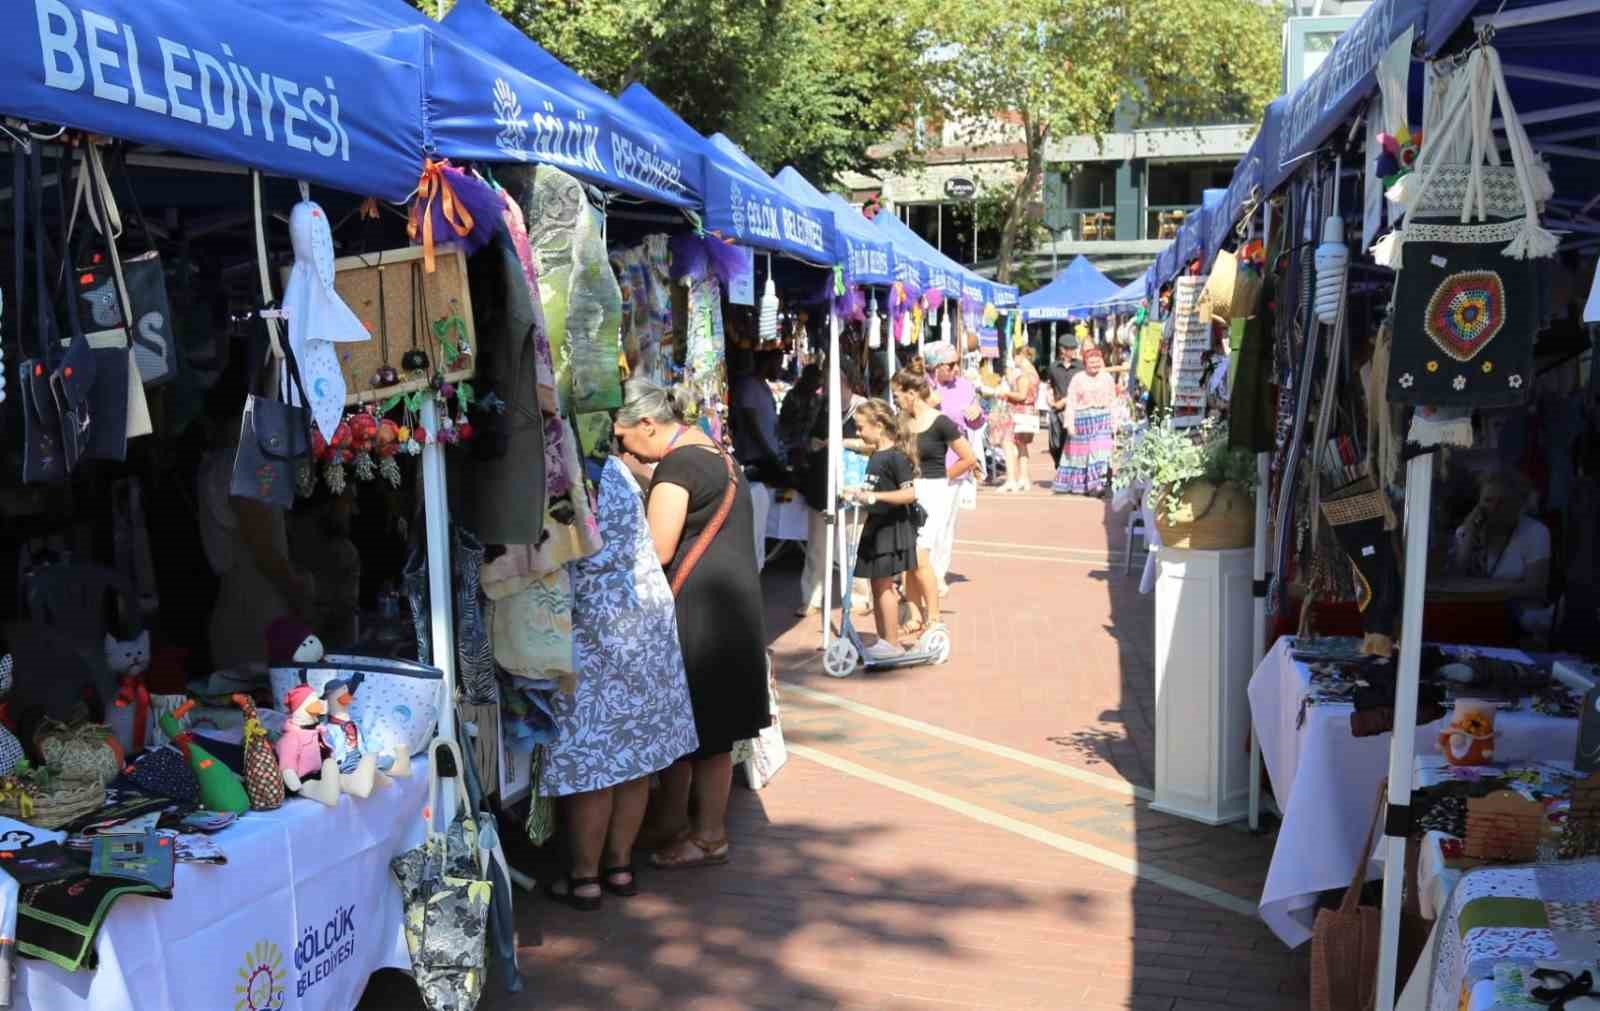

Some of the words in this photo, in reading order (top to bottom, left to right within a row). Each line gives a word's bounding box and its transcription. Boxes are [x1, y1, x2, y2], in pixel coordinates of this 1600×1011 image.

[35, 0, 350, 161] BELEDİYESİ
[295, 905, 355, 970] GÖLCÜK
[297, 935, 354, 997] BELEDİYESİ
